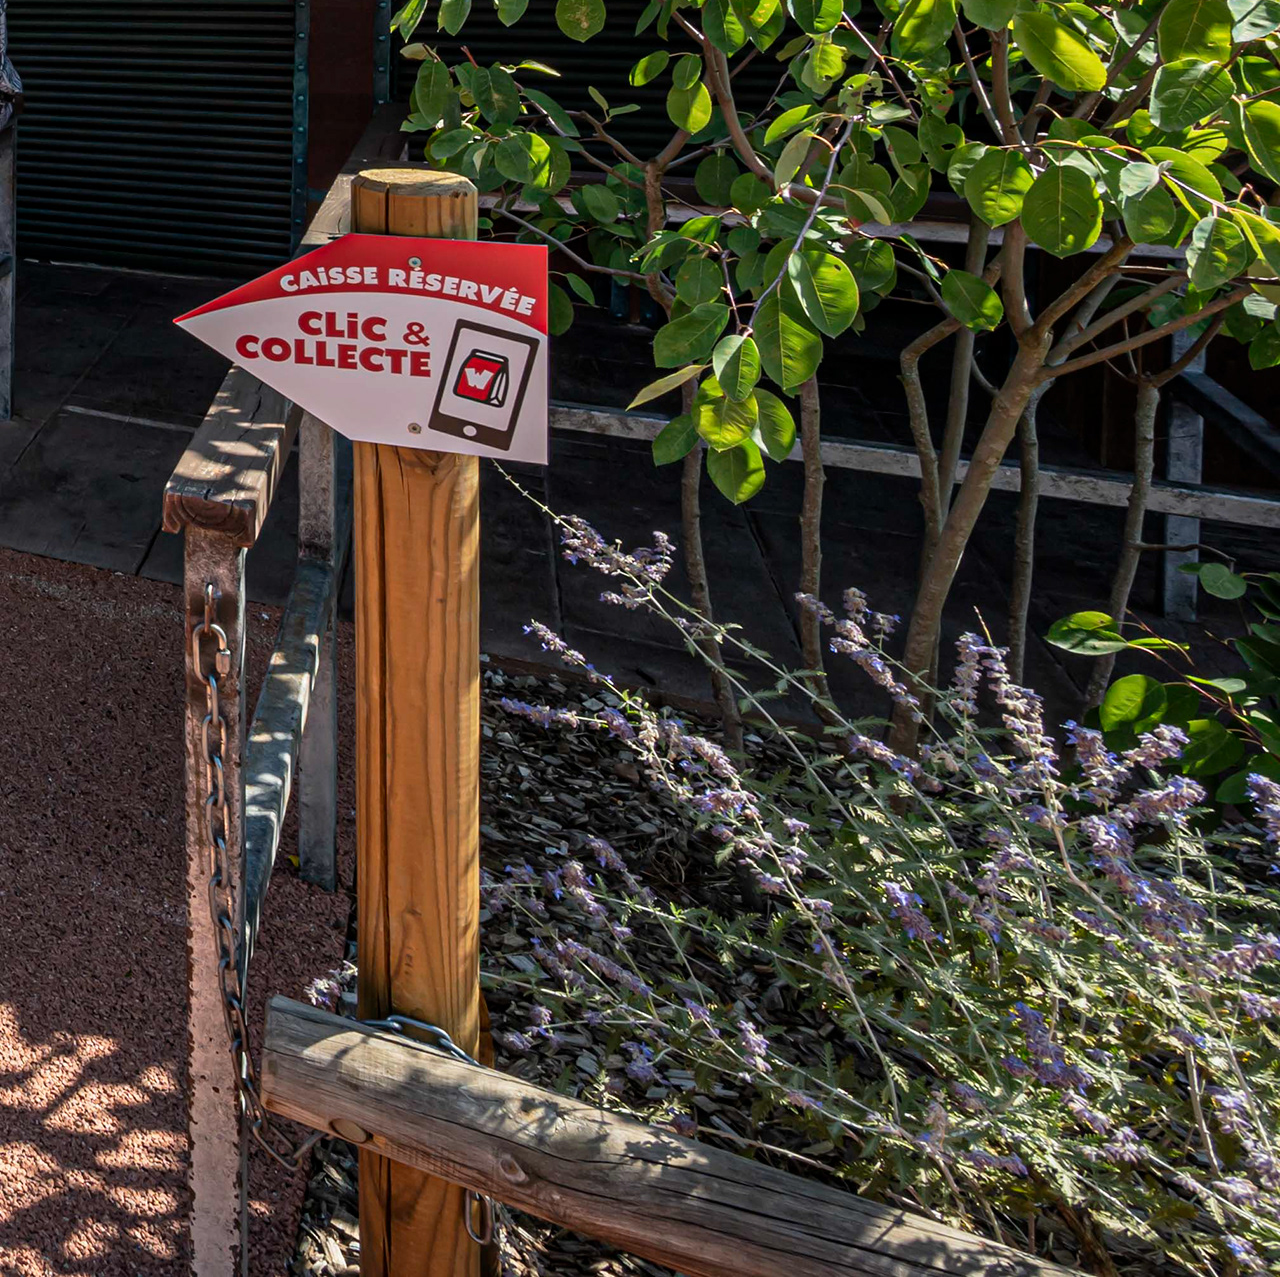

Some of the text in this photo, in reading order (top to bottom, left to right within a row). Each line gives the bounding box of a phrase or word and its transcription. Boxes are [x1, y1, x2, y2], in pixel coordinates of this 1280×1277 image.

[387, 267, 537, 316] RÉSERVÉE
[402, 321, 431, 346] &
[235, 334, 431, 378] COLLECTE
